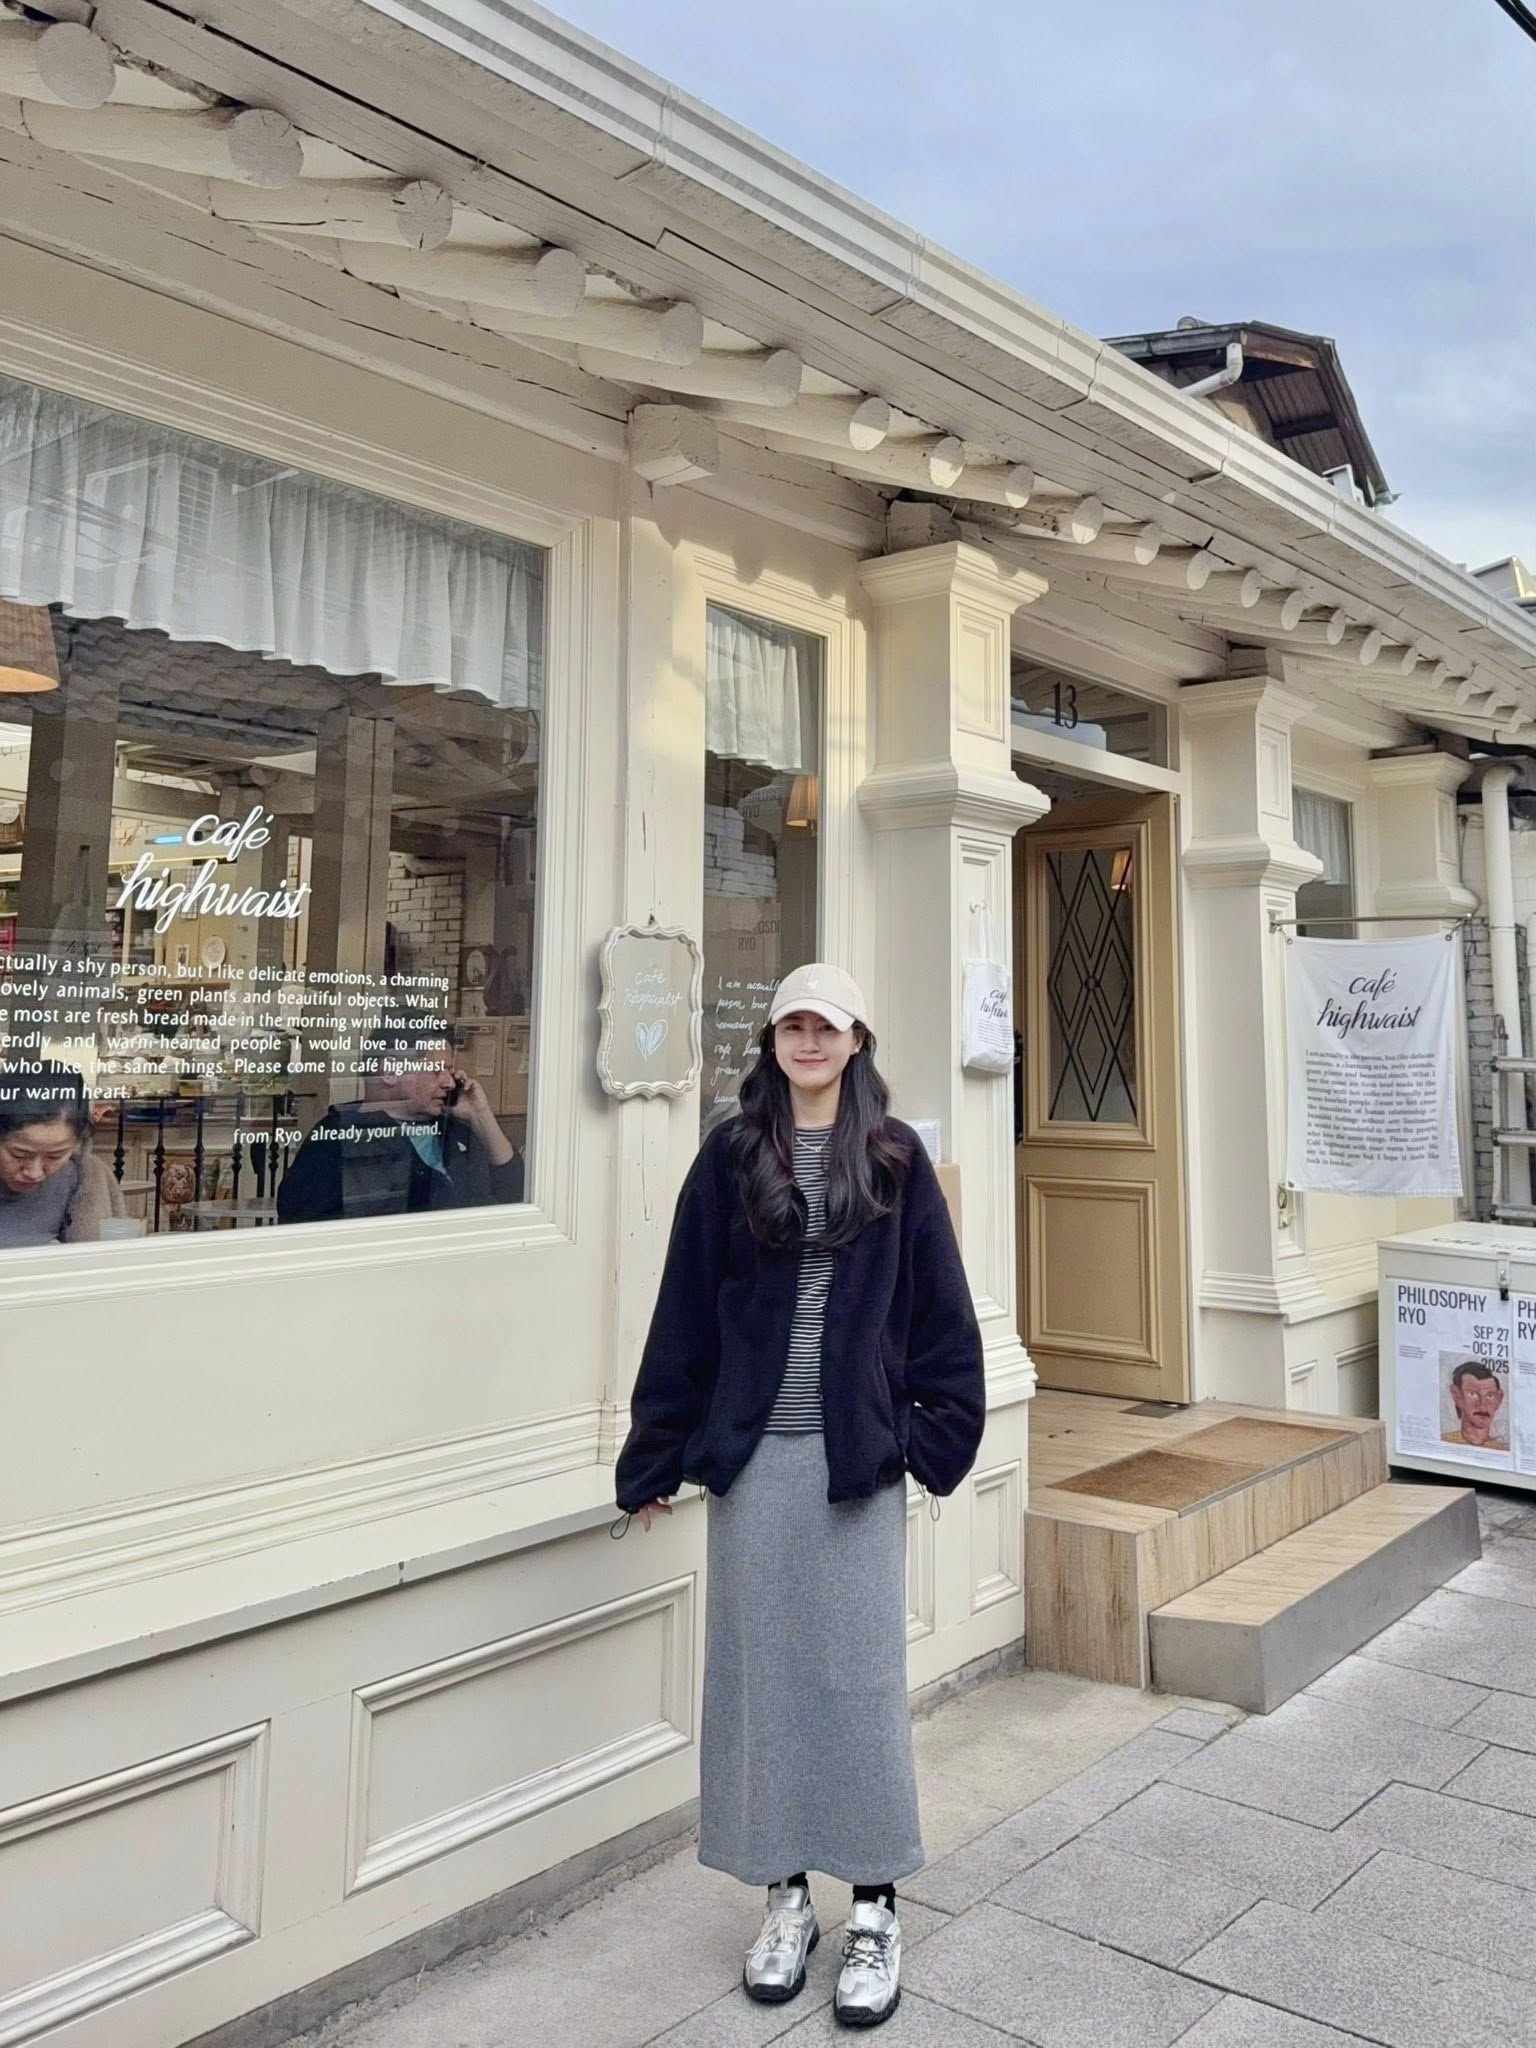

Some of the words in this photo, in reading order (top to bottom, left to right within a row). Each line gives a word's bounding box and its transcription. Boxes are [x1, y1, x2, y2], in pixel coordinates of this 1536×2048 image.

[1051, 682, 1078, 729] 13
[116, 852, 312, 934] highwaist
[62, 959, 72, 972] a
[78, 957, 105, 976] shy
[111, 961, 172, 978] person,
[178, 962, 203, 978] but
[208, 964, 212, 978] I
[218, 963, 244, 979] like
[249, 966, 305, 982] delicate
[309, 969, 376, 986] emotions,
[379, 974, 387, 986] a
[390, 973, 450, 991] charming
[57, 982, 129, 1002] animals,
[137, 988, 182, 1004] green
[190, 987, 236, 1006] plants
[243, 989, 271, 1005] and
[278, 990, 341, 1007] beautiful
[348, 993, 400, 1011] objects.
[405, 994, 439, 1009] What
[444, 995, 448, 1009] I
[14, 1008, 59, 1023] most
[64, 1010, 91, 1023] are
[96, 1007, 138, 1024] fresh
[144, 1010, 189, 1026] bread
[194, 1012, 236, 1027] made
[241, 1013, 255, 1027] in
[259, 1012, 283, 1027] the
[287, 1013, 347, 1032] morning
[351, 1014, 381, 1030] with
[385, 1015, 406, 1030] hot
[409, 1015, 448, 1031] coffee
[1316, 997, 1422, 1040] highwaist
[63, 1032, 96, 1049] and
[108, 1033, 221, 1050] warm-hearted
[309, 1036, 351, 1051] would
[360, 1037, 387, 1051] love
[394, 1038, 408, 1051] to
[415, 1038, 446, 1051] meet
[4, 1057, 43, 1075] who
[51, 1058, 82, 1074] like
[90, 1058, 119, 1075] the
[124, 1060, 168, 1075] same
[174, 1058, 227, 1077] things.
[234, 1058, 281, 1074] Please
[287, 1060, 326, 1074] come
[331, 1059, 345, 1074] to
[350, 1058, 379, 1073] café
[383, 1058, 445, 1076] highwiast
[26, 1086, 77, 1100] warm
[82, 1083, 131, 1100] heart.
[233, 1127, 269, 1145] from
[275, 1127, 302, 1146] Ryo
[310, 1125, 362, 1143] already
[367, 1126, 397, 1143] your
[400, 1121, 442, 1137] friend.
[1398, 1284, 1487, 1313] PHILOSOPHY
[1398, 1305, 1426, 1326] RYO
[1473, 1325, 1494, 1341] SEP
[1496, 1327, 1510, 1342] 27
[1472, 1340, 1494, 1356] OCT
[1496, 1343, 1509, 1358] 21
[1481, 1358, 1510, 1374] 2025
